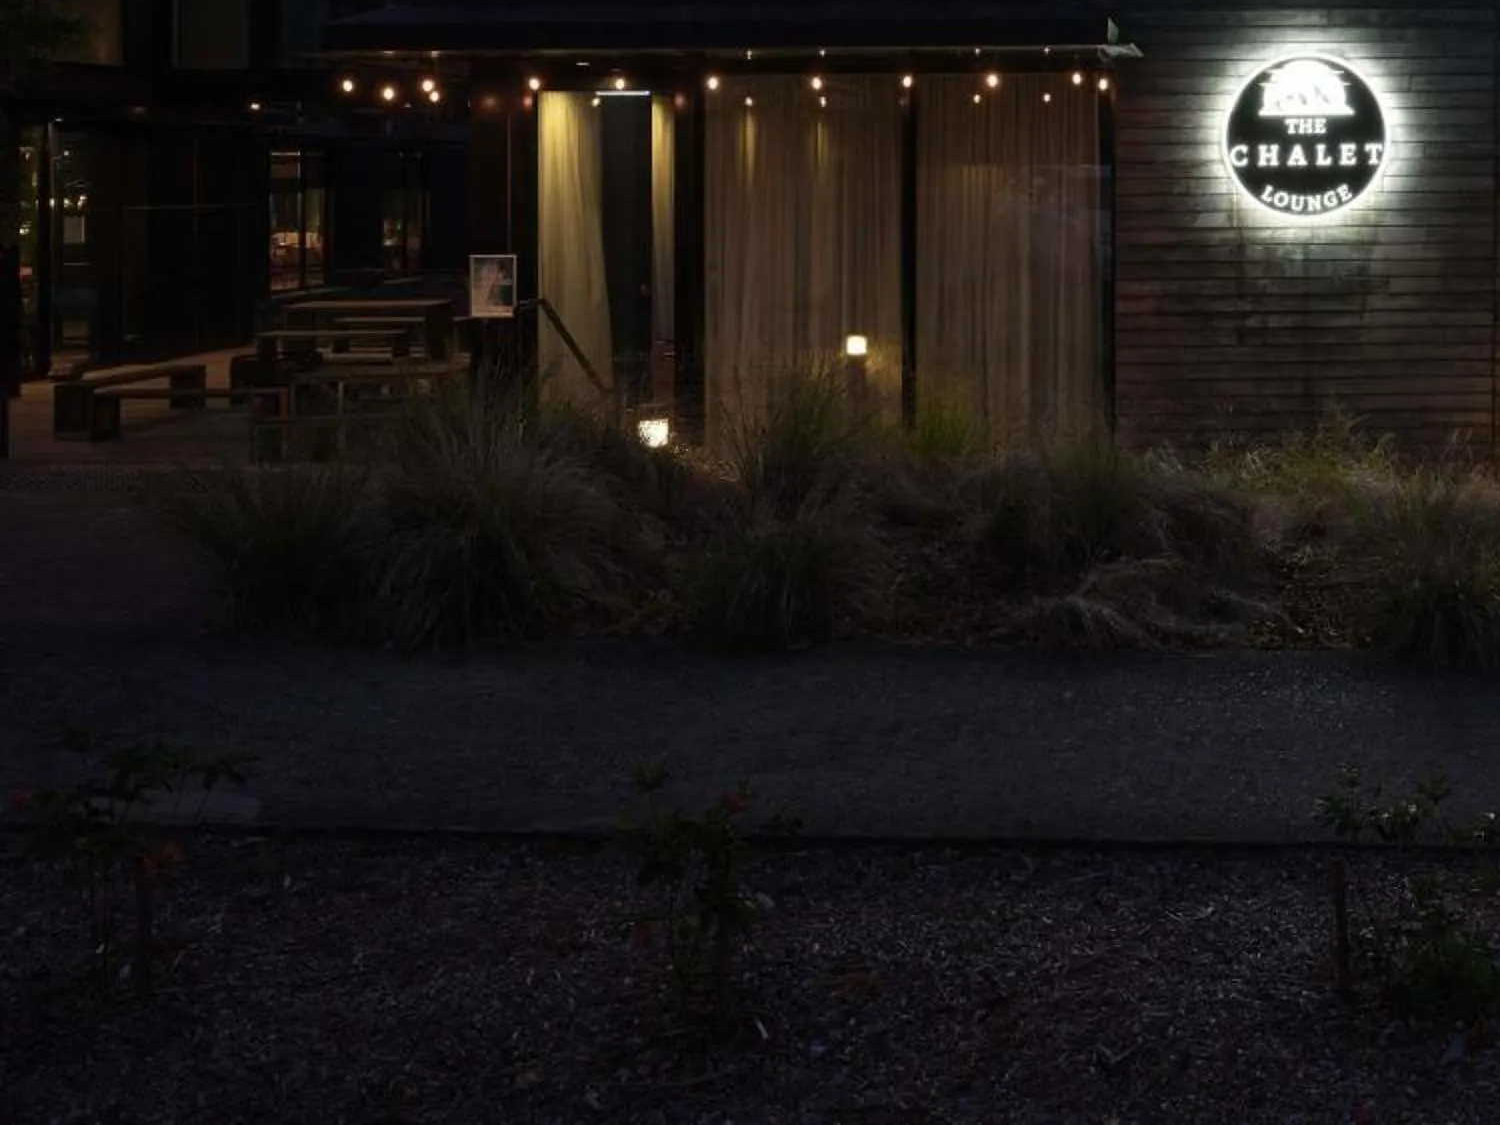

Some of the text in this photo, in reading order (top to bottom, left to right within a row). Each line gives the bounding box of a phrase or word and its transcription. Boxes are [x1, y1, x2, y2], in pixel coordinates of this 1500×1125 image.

[1285, 118, 1327, 134] THE
[1230, 142, 1383, 167] CHALET
[1261, 184, 1353, 211] LOUNGE
